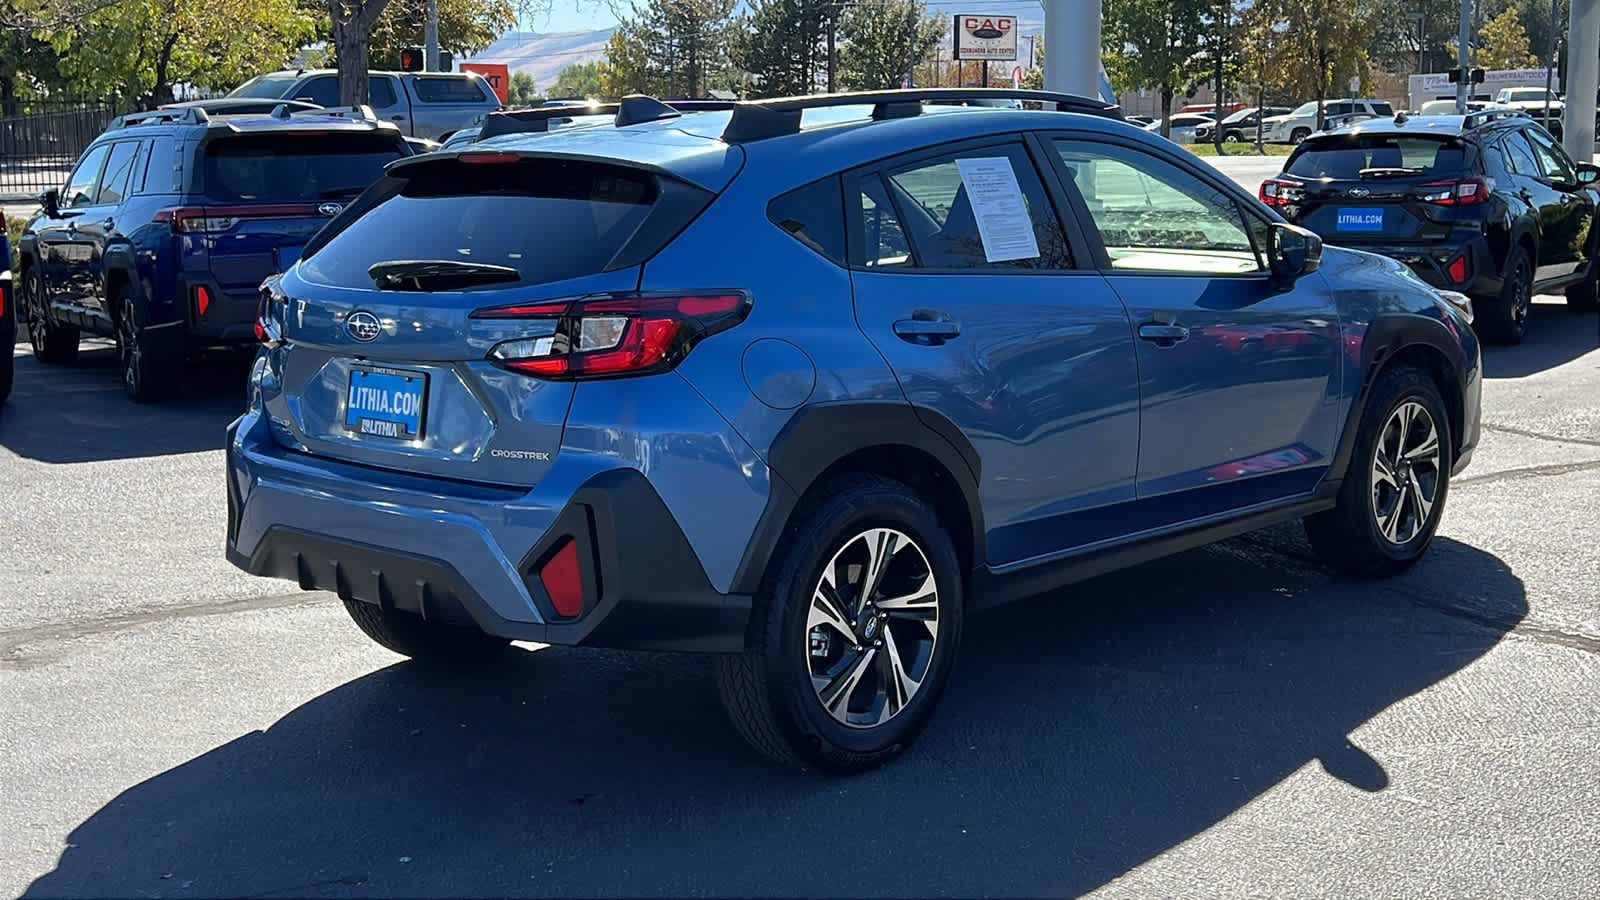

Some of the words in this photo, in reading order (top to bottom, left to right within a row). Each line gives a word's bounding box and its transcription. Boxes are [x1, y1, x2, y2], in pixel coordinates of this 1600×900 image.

[965, 18, 1011, 30] CAC
[1338, 215, 1383, 225] LITHIA.COM
[348, 386, 421, 417] LITHIA.COM
[370, 420, 398, 437] LITHIA
[491, 449, 550, 461] CROSSTREK
